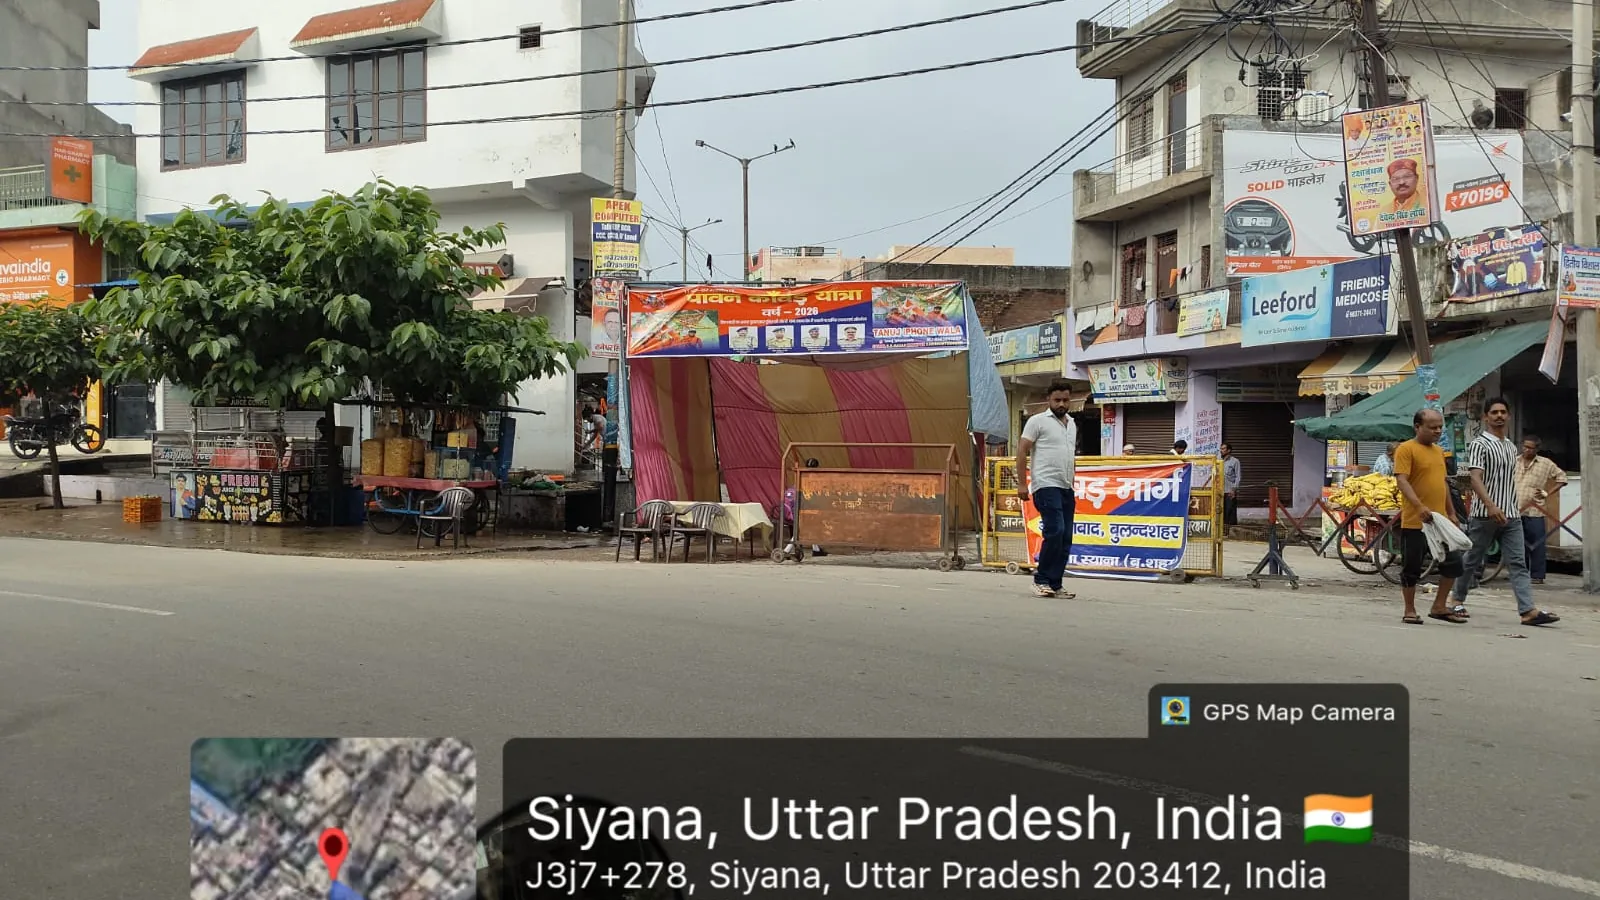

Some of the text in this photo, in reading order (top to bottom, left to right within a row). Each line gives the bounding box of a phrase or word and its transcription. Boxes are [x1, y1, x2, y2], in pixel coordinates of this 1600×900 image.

[1240, 157, 1302, 173] Shine
[1284, 162, 1313, 174] 100
[1247, 180, 1285, 193] SOLID
[594, 212, 640, 223] COMPUTER
[15, 274, 51, 283] PHARMACY
[1340, 275, 1385, 292] FRIENDS
[687, 292, 741, 304] पावन
[815, 289, 863, 301] यात्रा
[1252, 286, 1317, 316] Leeford
[761, 306, 781, 316] वर्ष
[795, 307, 819, 316] 2026
[873, 327, 901, 337] TANUJ
[936, 324, 963, 335] WALA
[1122, 383, 1149, 391] COMPUTERS
[221, 474, 259, 487] FRESH
[1116, 468, 1184, 503] मार्ग
[1080, 554, 1120, 567] स्याना
